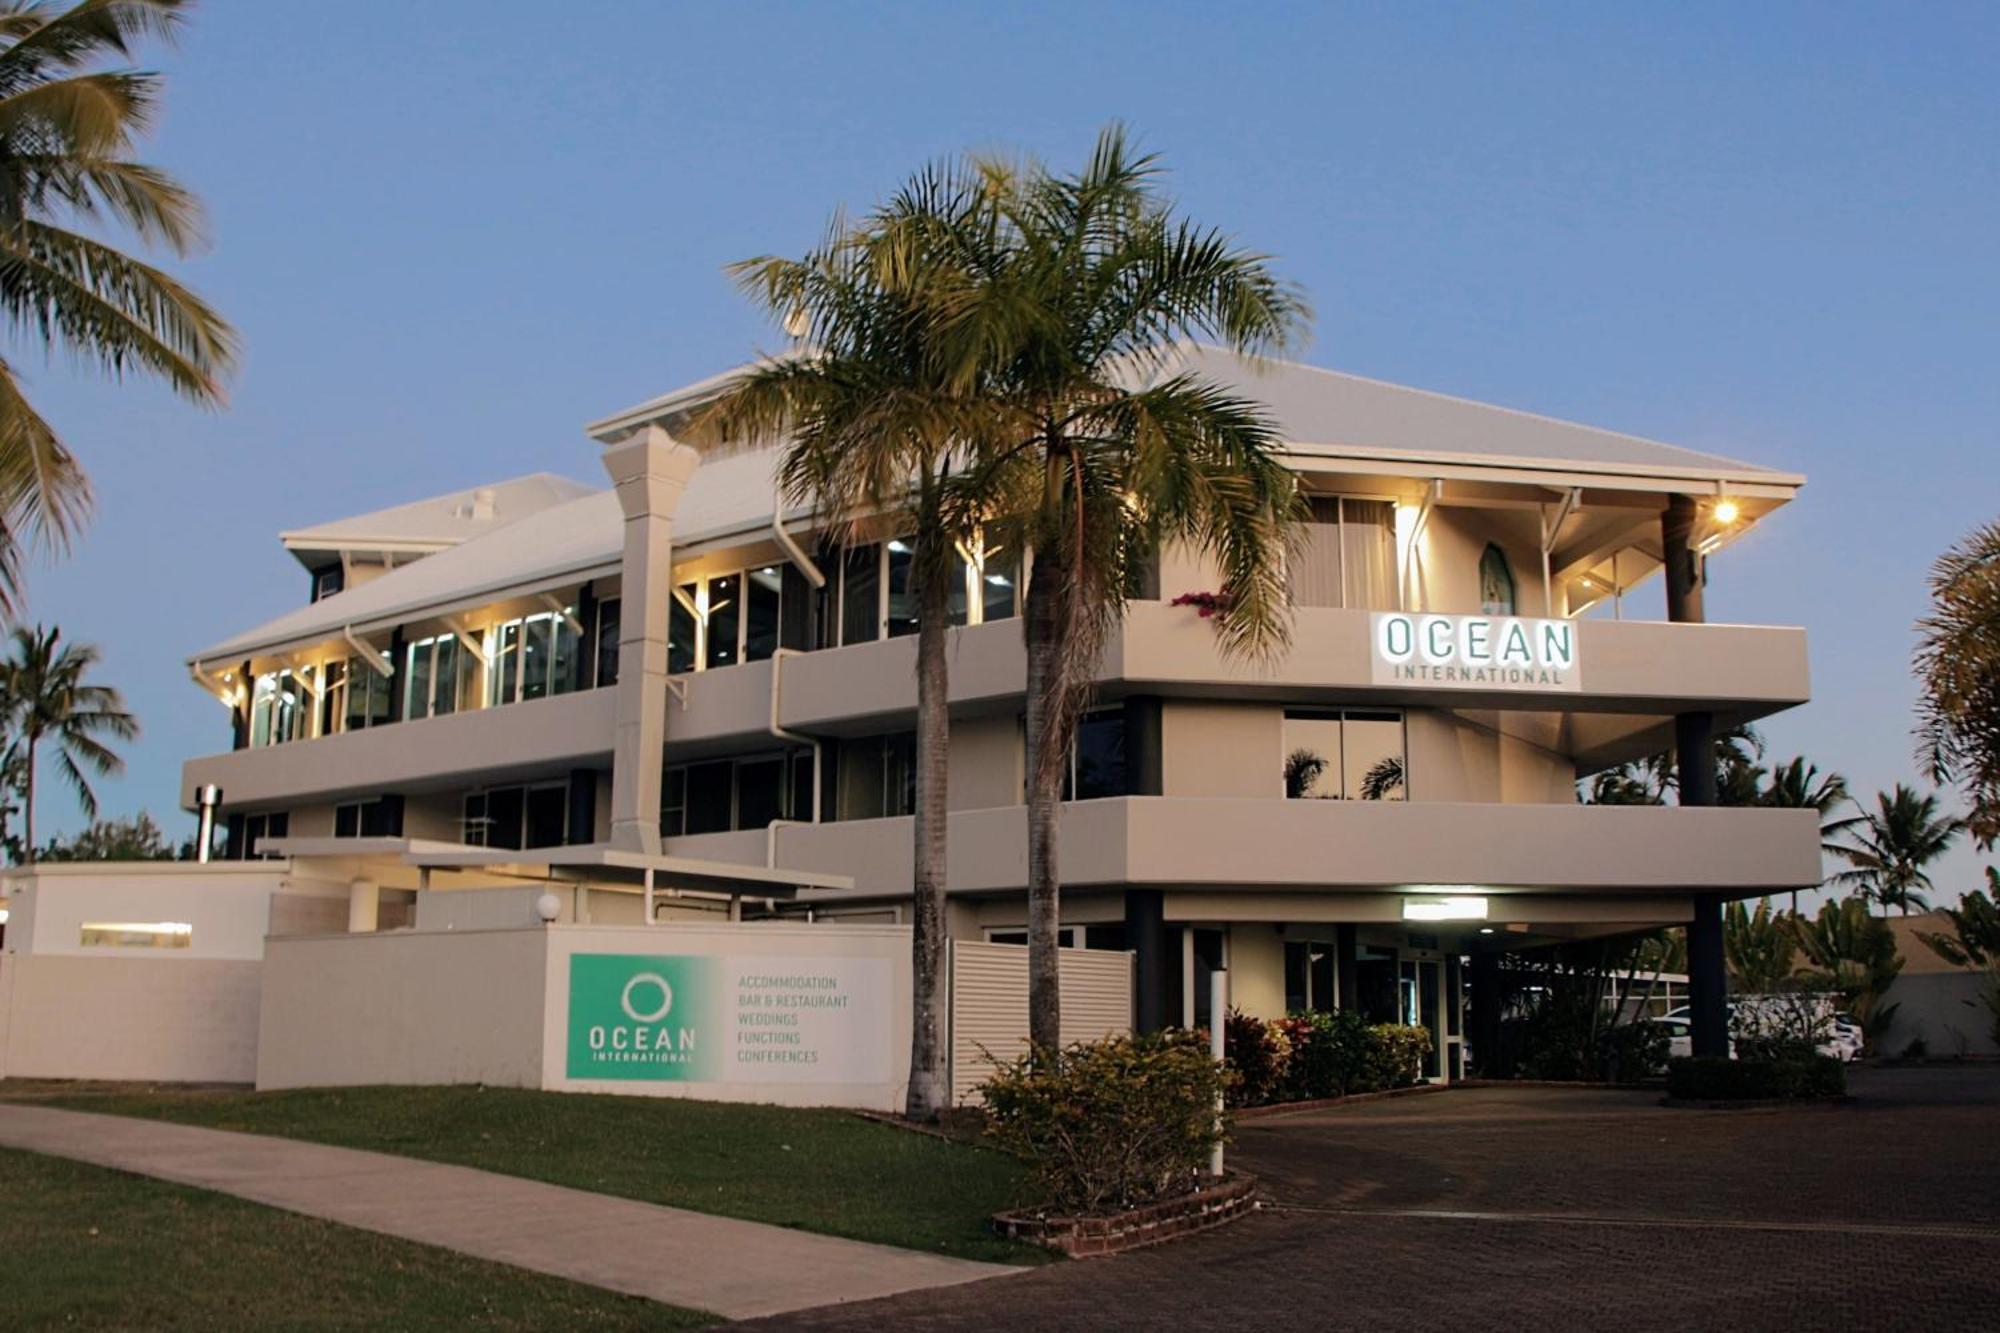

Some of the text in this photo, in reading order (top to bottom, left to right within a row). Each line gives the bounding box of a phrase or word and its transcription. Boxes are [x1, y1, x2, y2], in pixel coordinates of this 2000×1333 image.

[1387, 618, 1571, 663] OCEAN
[1394, 665, 1563, 685] INTERNATIONAL
[738, 975, 837, 990] ACCOMMODATION
[739, 994, 761, 1008] BAR
[776, 994, 848, 1009] RESTAURANT
[738, 1013, 799, 1026] WEDDINGS
[589, 1025, 695, 1050] OCEAN
[738, 1032, 801, 1045] FUNCTIONS
[593, 1052, 693, 1063] INTERNATIONAL
[737, 1050, 819, 1064] CONFERENCES
